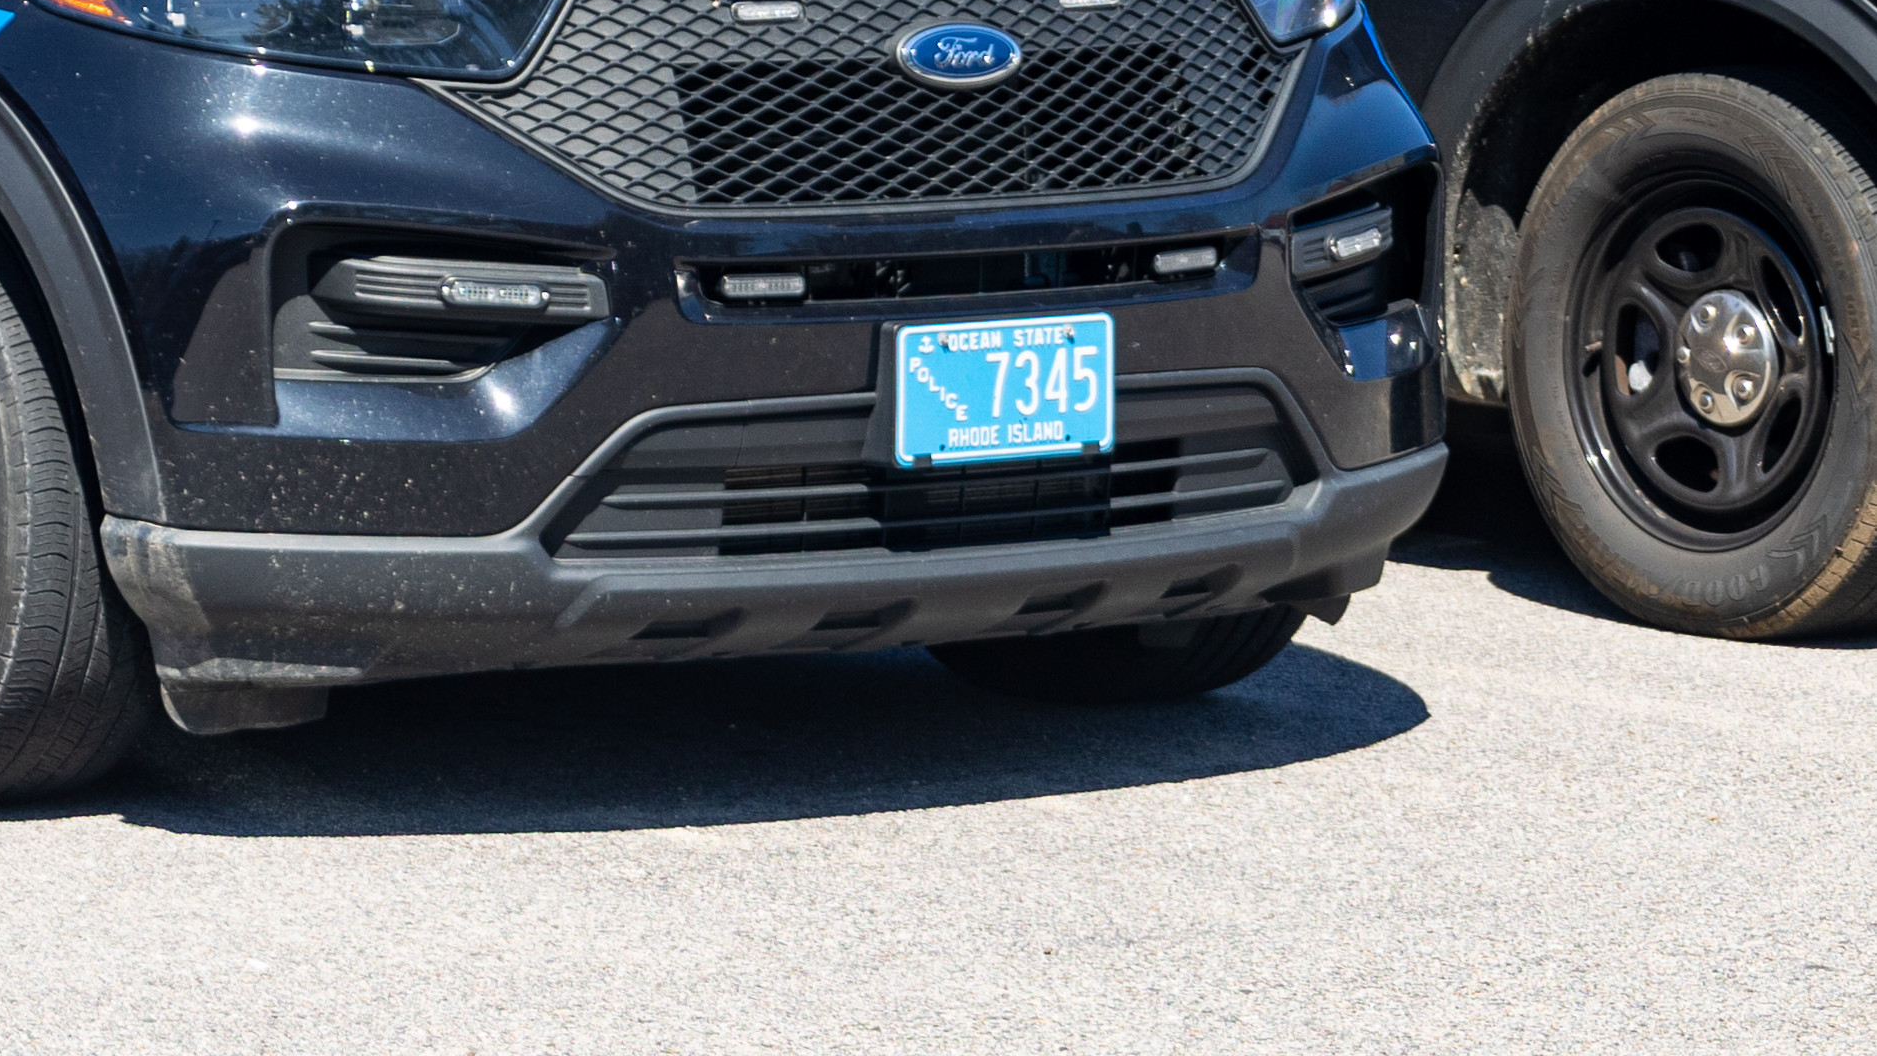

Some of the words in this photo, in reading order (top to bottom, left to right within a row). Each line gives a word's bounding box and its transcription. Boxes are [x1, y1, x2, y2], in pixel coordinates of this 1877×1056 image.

[933, 36, 995, 68] Ford
[948, 331, 1002, 352] OCEAN
[1013, 326, 1064, 347] STATE
[909, 357, 969, 422] POLICE
[986, 346, 1098, 418] 7345
[948, 425, 1001, 448] RHODE
[1008, 421, 1064, 444] ISLAND
